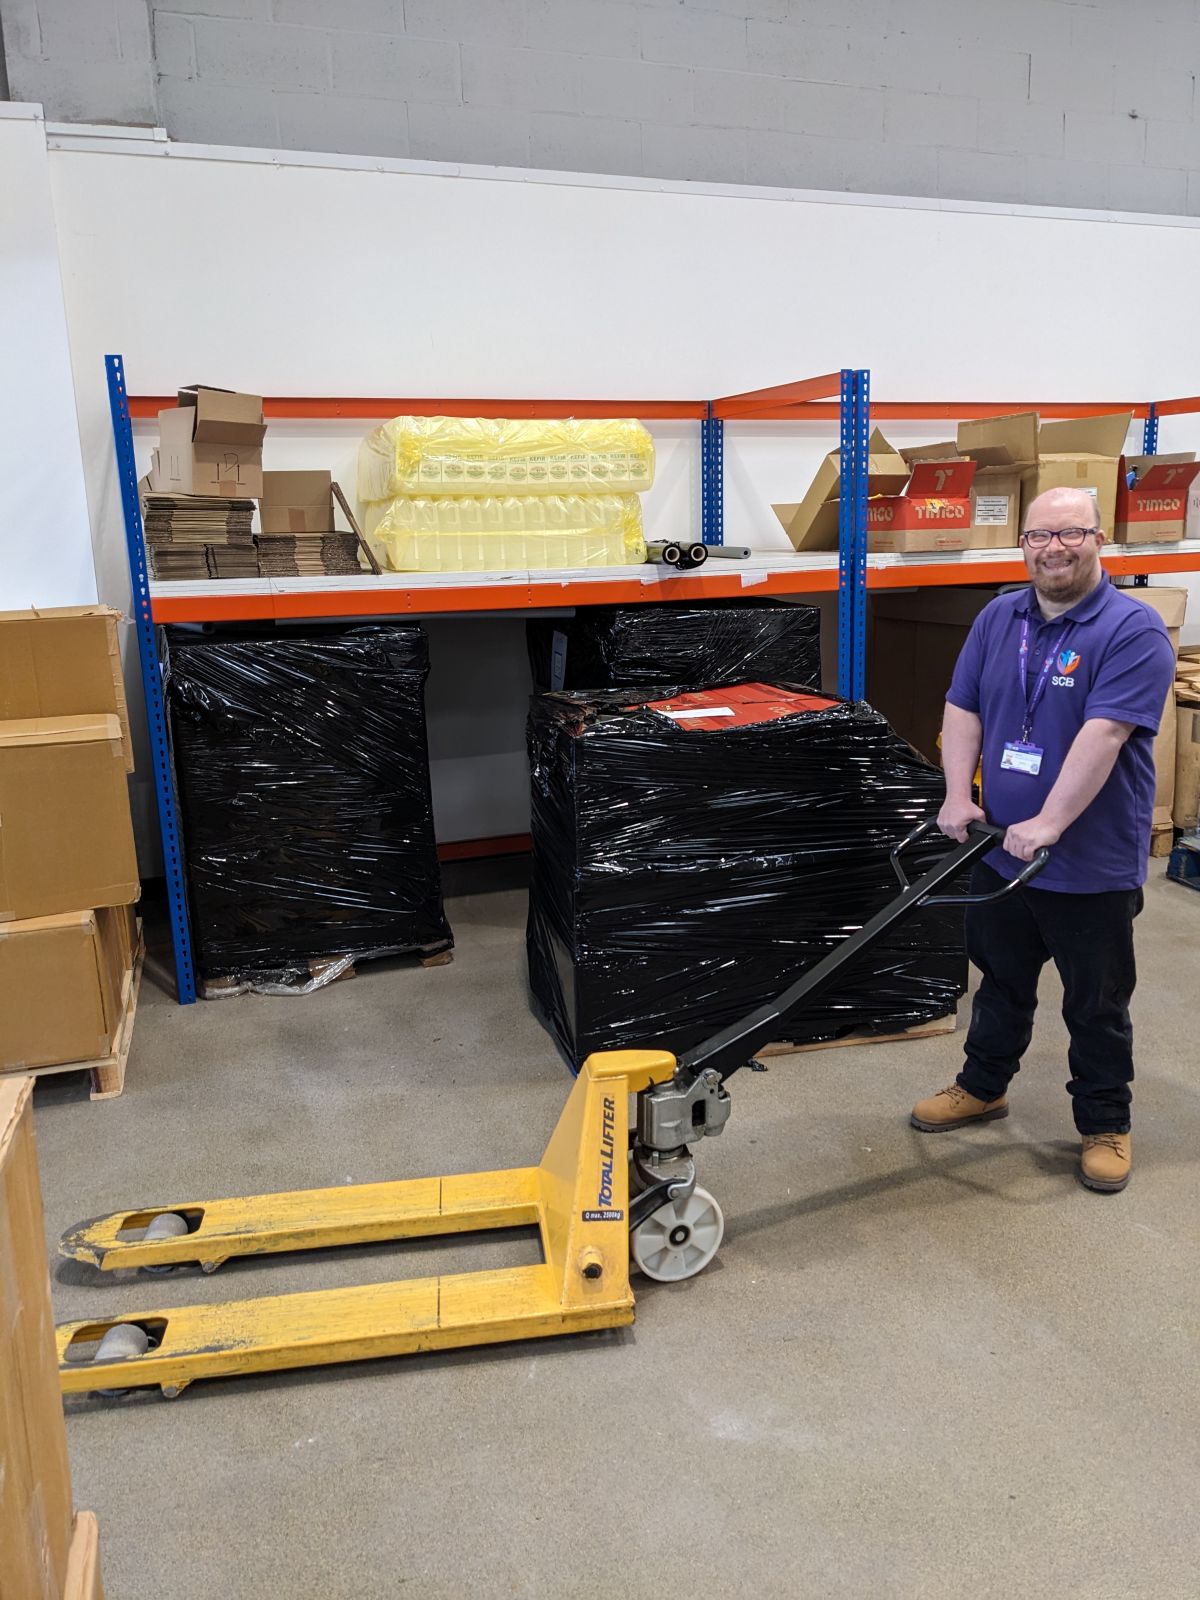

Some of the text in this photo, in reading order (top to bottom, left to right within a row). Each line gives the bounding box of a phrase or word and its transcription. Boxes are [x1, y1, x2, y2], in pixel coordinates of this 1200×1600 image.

[914, 505, 965, 519] TIMCO
[1137, 498, 1181, 512] TIMCO
[1051, 676, 1075, 687] SCB
